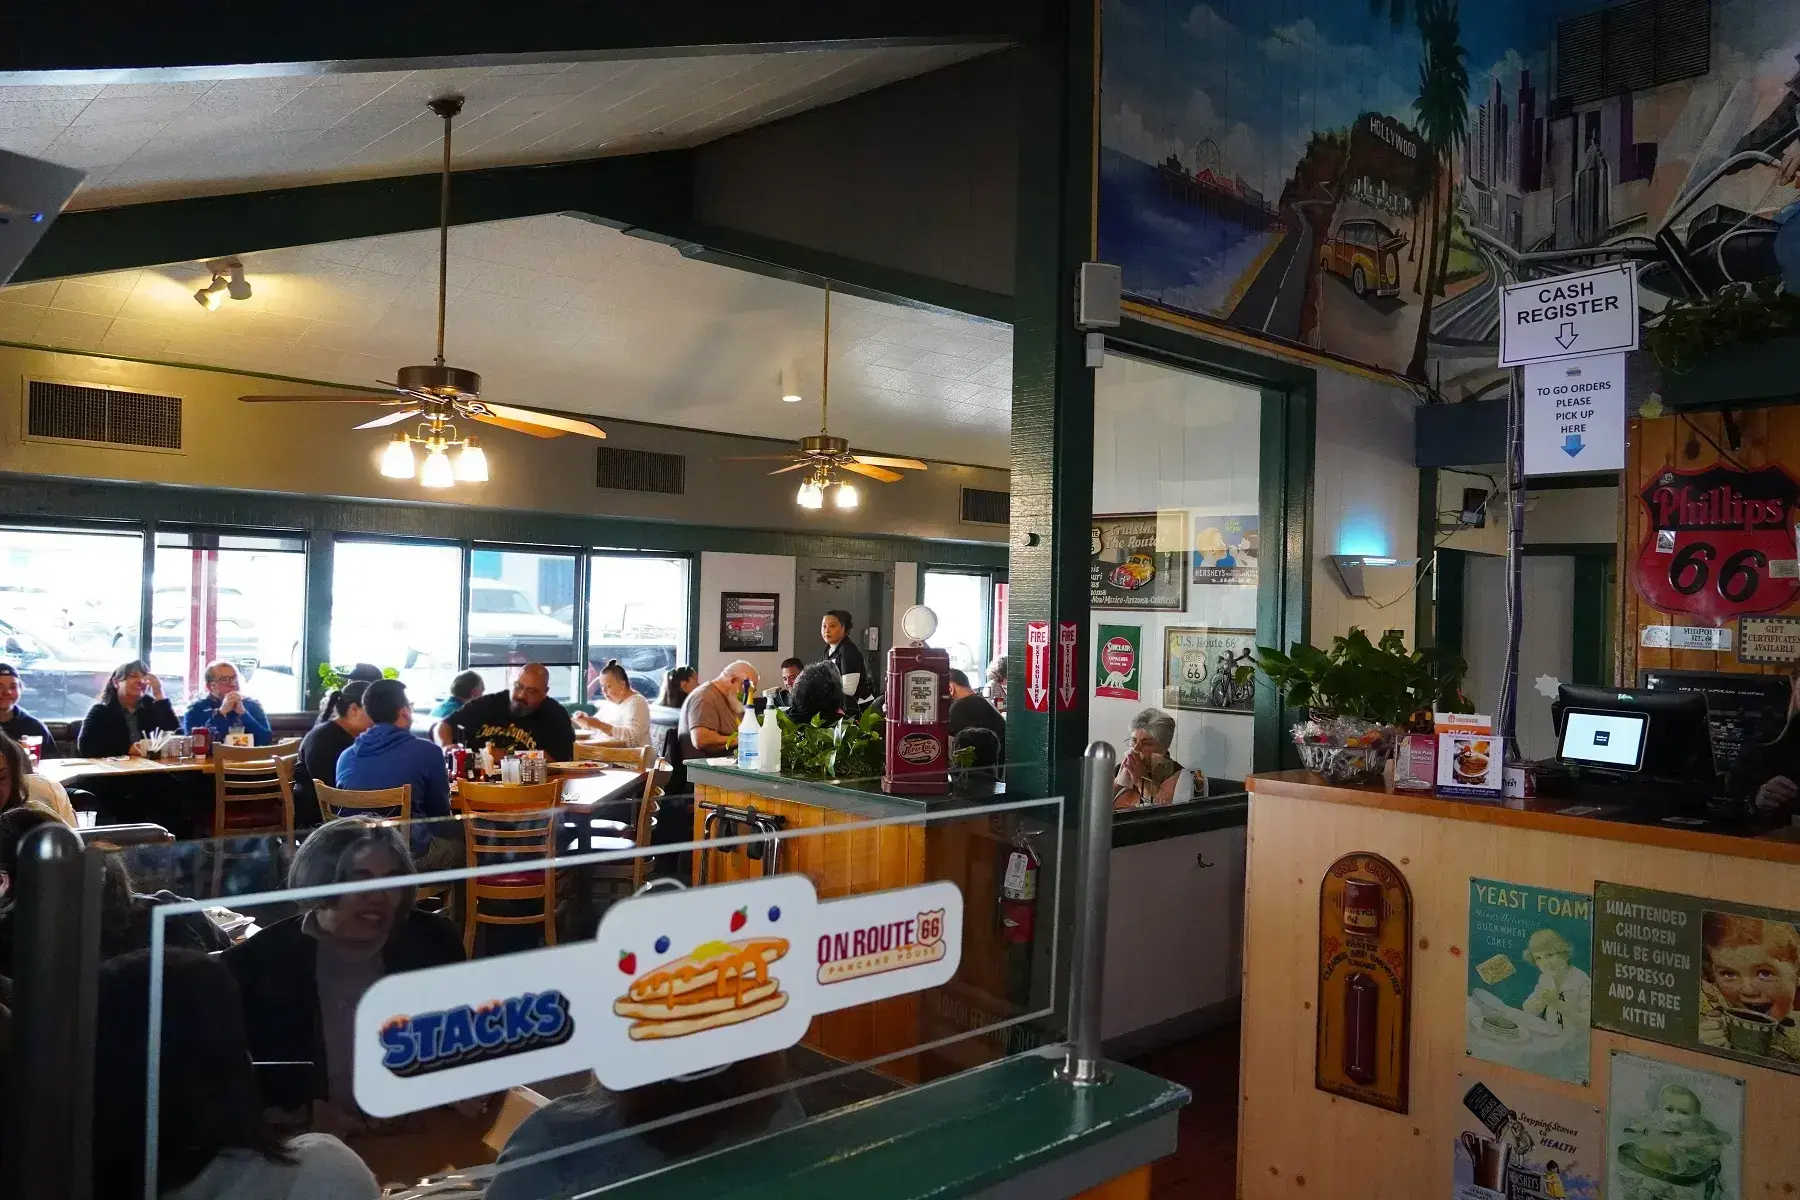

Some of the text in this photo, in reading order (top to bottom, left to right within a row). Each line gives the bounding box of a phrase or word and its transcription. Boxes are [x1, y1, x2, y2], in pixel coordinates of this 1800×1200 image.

[1370, 117, 1417, 159] HOLLYWOOD
[1538, 280, 1594, 304] CASH
[1517, 295, 1619, 325] REGISTER
[1537, 381, 1611, 396] TO GO ORDERS
[1556, 396, 1591, 408] PLEASE
[1555, 409, 1594, 421] PICK UP
[1561, 423, 1587, 433] HERE
[1652, 485, 1784, 535] Phillips
[1668, 541, 1768, 602] 66
[1030, 631, 1046, 643] FIRE
[1061, 629, 1075, 642] FIRE
[1747, 634, 1800, 644] CERTIFICATES
[1765, 625, 1784, 634] GIFT
[1175, 635, 1236, 649] U.S. Route 66
[1753, 643, 1796, 653] AVAILABLE
[1187, 668, 1201, 679] 66
[1332, 860, 1359, 878] USE
[1475, 884, 1588, 921] YEAST FOAM
[1606, 899, 1688, 926] UNATTENDED
[1476, 921, 1528, 939] BUCKWHEAT
[1615, 922, 1676, 946] CHILDREN
[817, 917, 940, 966] ON ROUTE 66
[1486, 935, 1513, 950] CAKES
[1601, 939, 1691, 971] WILL BE GIVEN
[827, 955, 890, 976] PANCAKE
[1615, 963, 1675, 988] ESPRESSO
[1608, 982, 1682, 1011] AND A FREE
[1622, 1005, 1666, 1029] KITTEN
[380, 989, 572, 1074] STACKS
[1518, 1112, 1578, 1137] Stepping Stones
[1539, 1129, 1547, 1137] to
[1540, 1137, 1577, 1155] HEALTH
